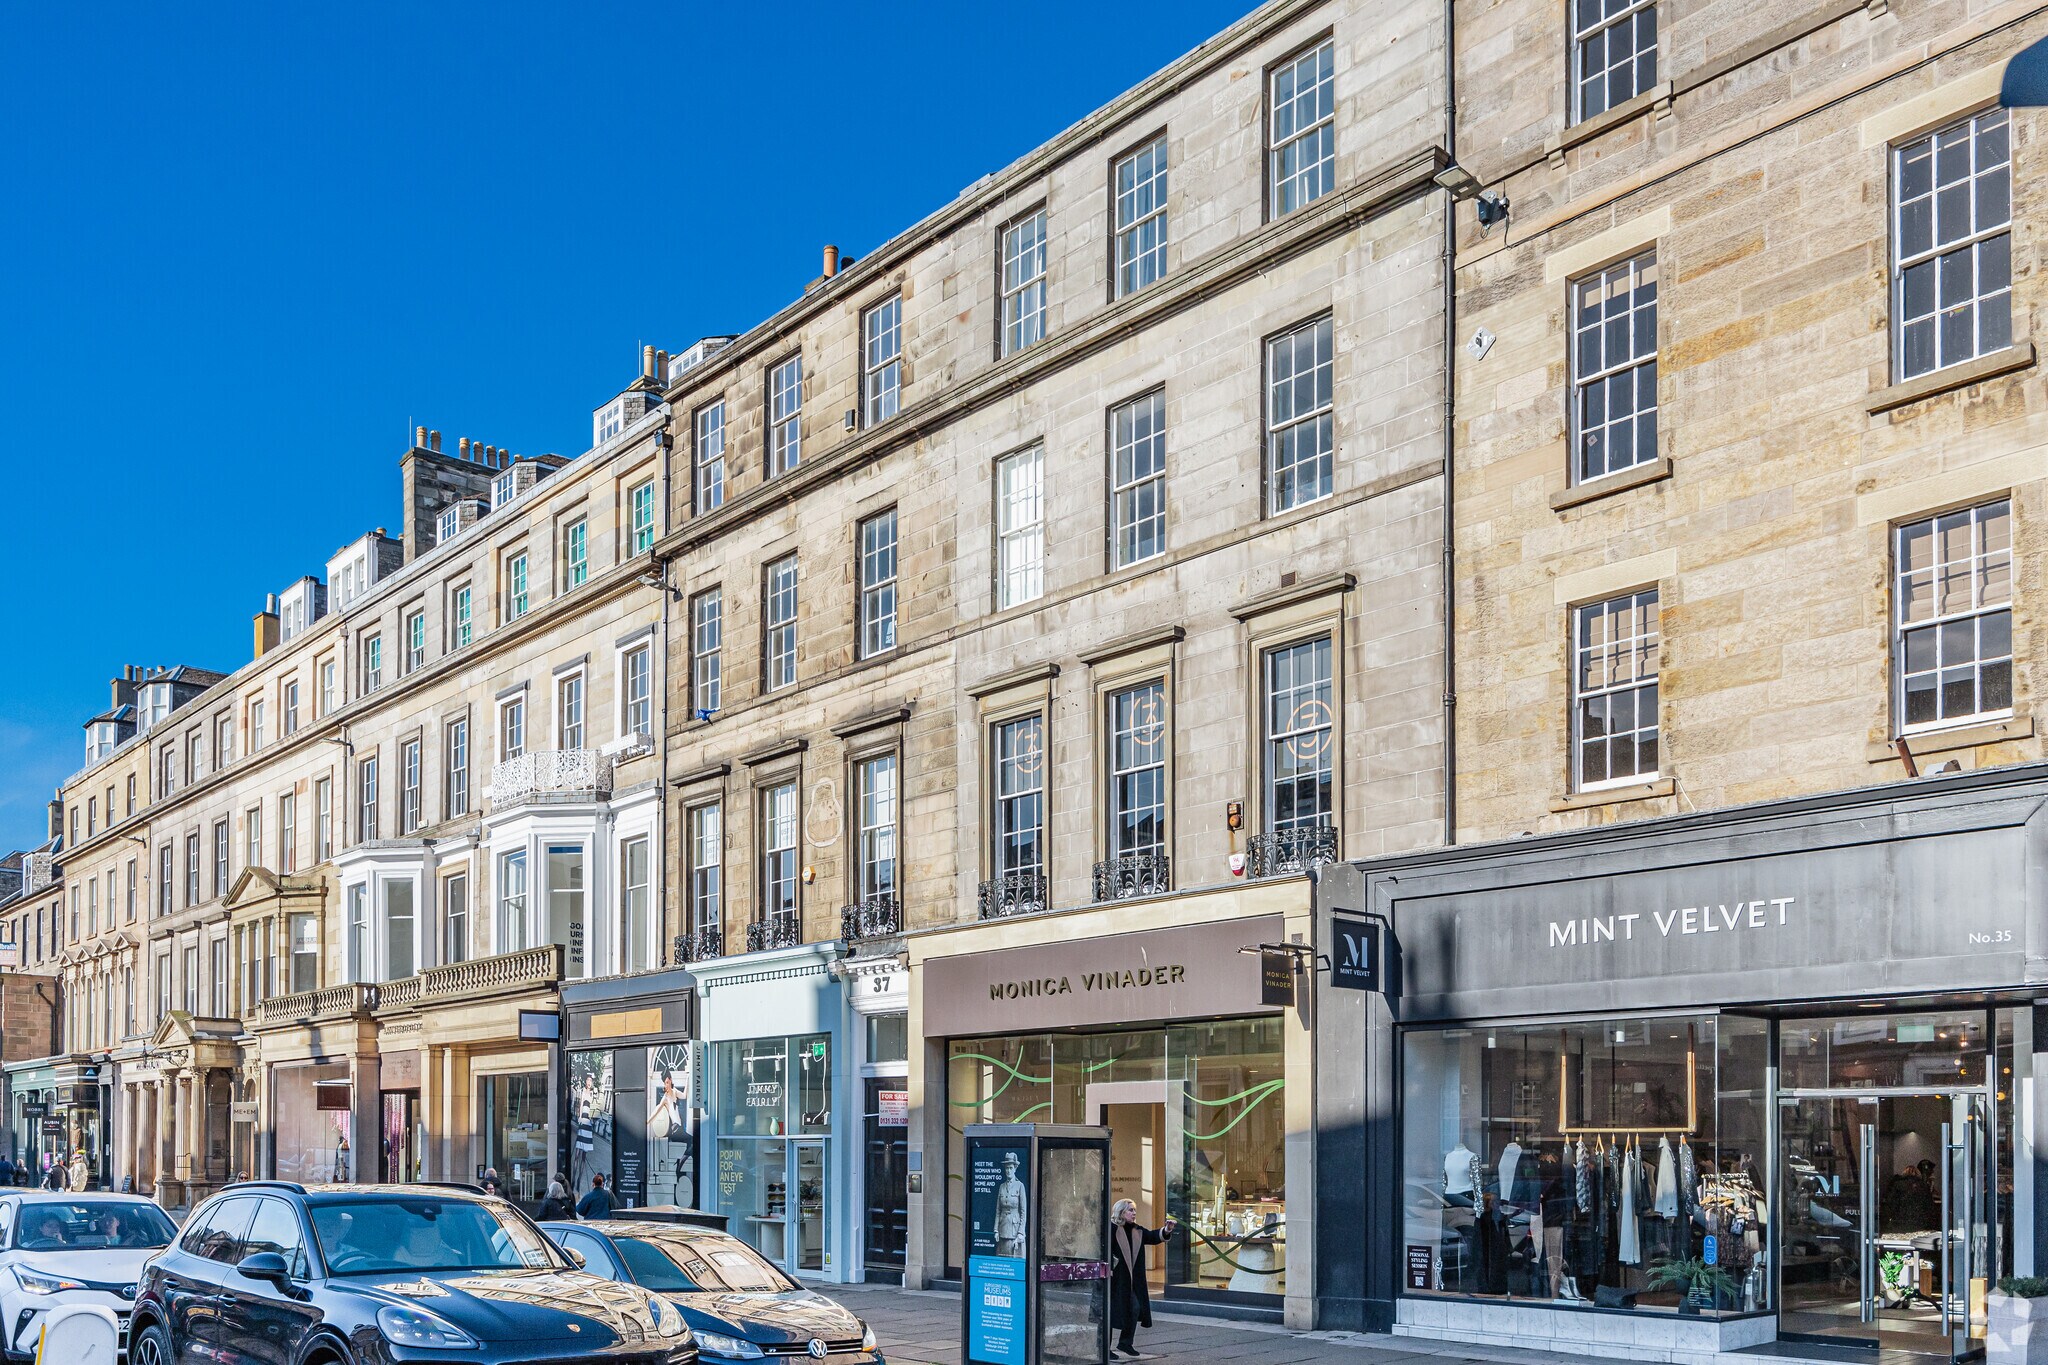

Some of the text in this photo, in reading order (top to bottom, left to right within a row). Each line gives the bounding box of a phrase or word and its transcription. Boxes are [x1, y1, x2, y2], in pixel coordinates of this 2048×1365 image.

[1549, 897, 1796, 947] MINT VELVET
[1969, 929, 2012, 945] No.35
[1343, 934, 1368, 969] M
[1266, 971, 1290, 980] MONICA
[1354, 969, 1371, 977] VELVET
[873, 976, 890, 993] 37
[989, 964, 1185, 1000] MONICA VINADER
[1265, 980, 1292, 989] VINADER
[746, 1084, 778, 1094] JIMMY
[745, 1097, 778, 1107] FAIRLY
[720, 1150, 742, 1160] POP IN
[720, 1161, 734, 1171] FOR
[720, 1172, 744, 1182] AN EYE
[720, 1183, 736, 1193] TEST
[984, 1287, 1012, 1296] MUSEUMS
